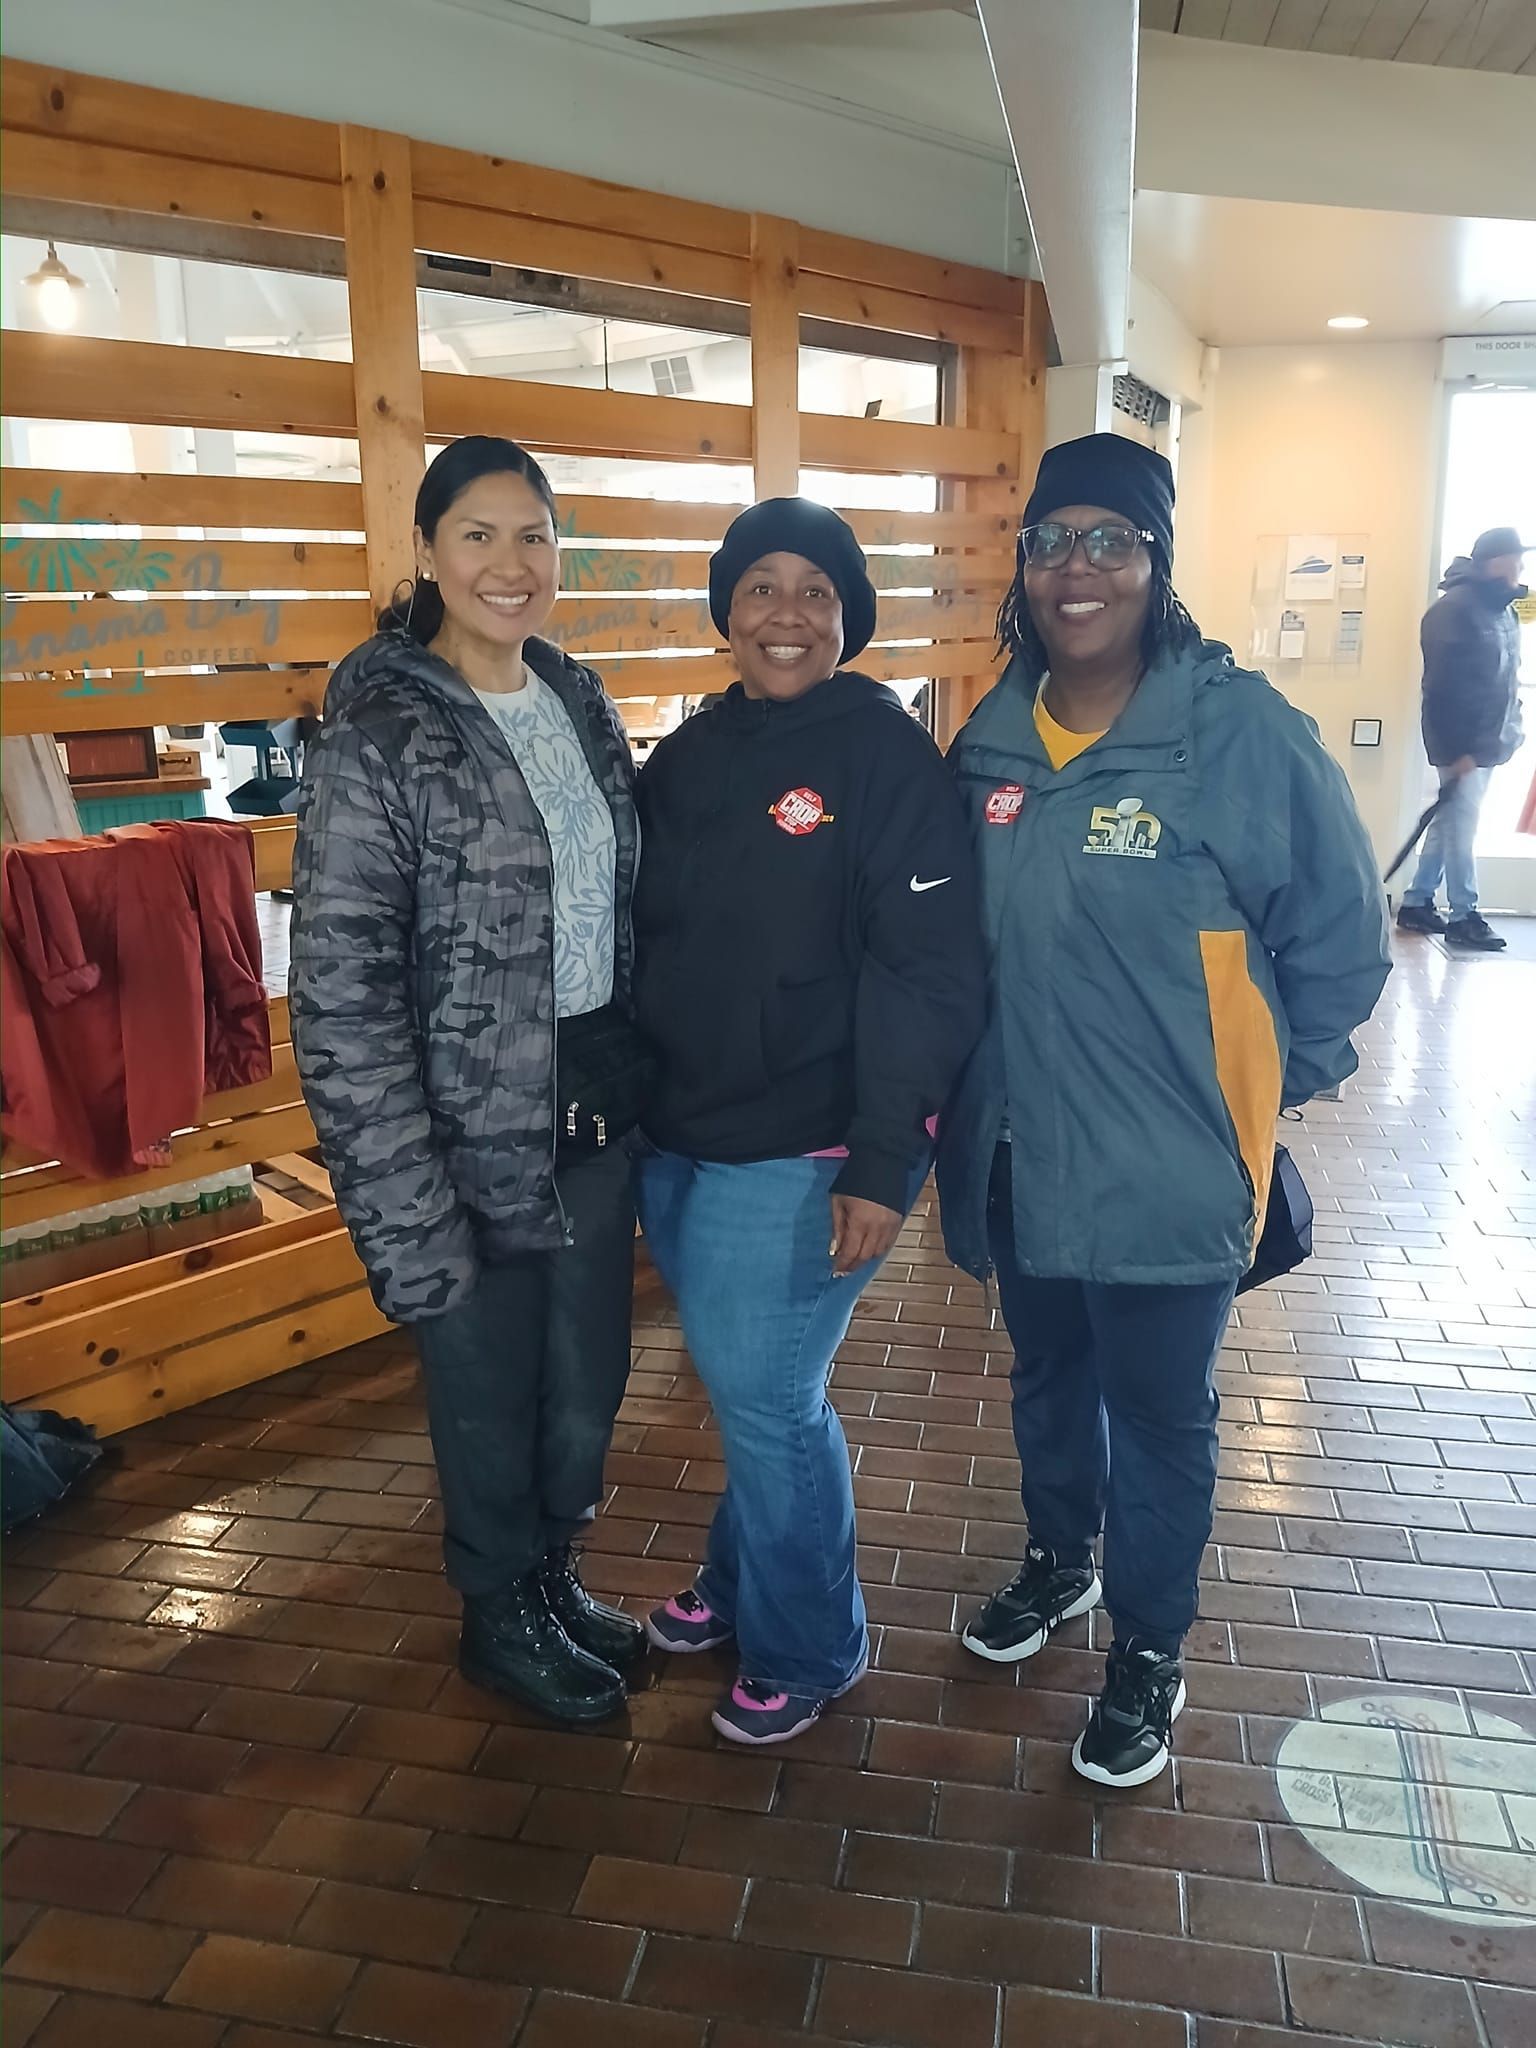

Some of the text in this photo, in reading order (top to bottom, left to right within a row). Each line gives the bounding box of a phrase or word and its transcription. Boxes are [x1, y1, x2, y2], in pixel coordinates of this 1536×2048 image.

[1, 585, 168, 665] anama
[164, 648, 256, 664] COFFEE
[1087, 807, 1162, 848] 50
[1122, 847, 1151, 857] BOWL
[1291, 1778, 1332, 1804] CROSS
